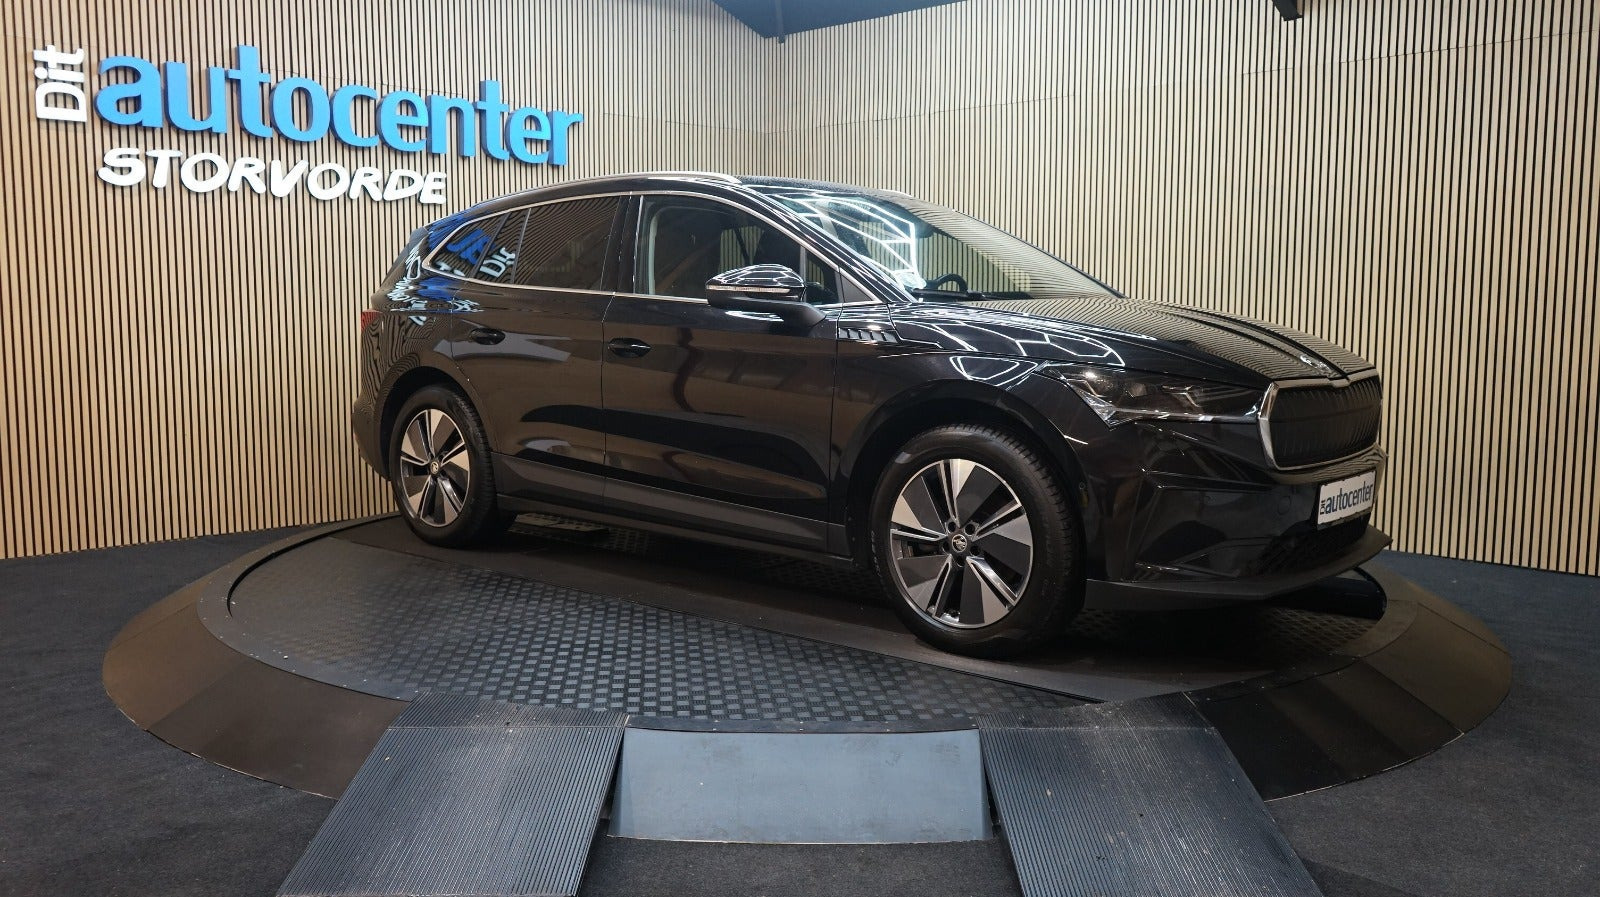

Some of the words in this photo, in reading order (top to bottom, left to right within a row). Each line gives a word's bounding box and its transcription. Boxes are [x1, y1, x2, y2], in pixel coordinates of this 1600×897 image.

[33, 44, 88, 122] Dit
[94, 44, 583, 166] autocenter
[97, 148, 446, 205] STORVORDE
[1325, 481, 1374, 515] autocenter
